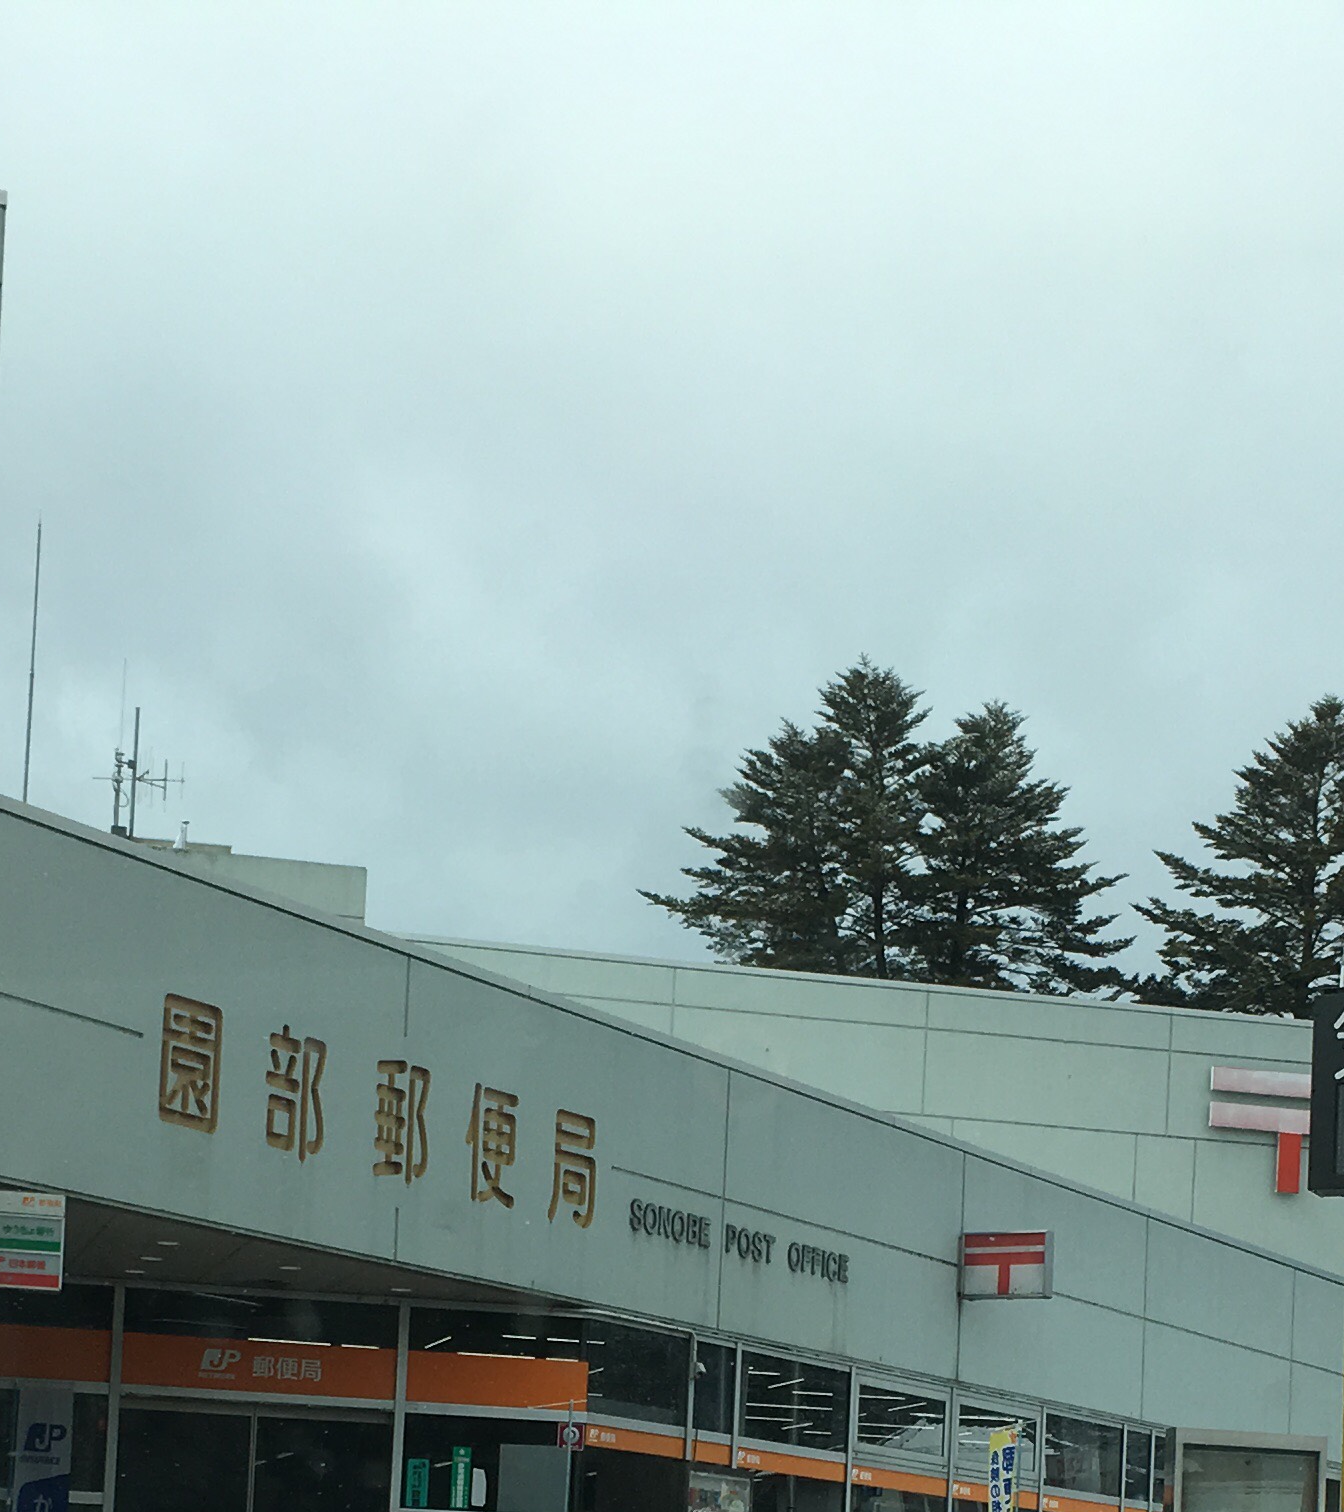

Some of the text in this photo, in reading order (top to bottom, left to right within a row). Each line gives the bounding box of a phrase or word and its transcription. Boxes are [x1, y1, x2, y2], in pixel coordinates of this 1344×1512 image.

[159, 992, 597, 1229] 園部郵便局
[629, 1198, 849, 1284] SONOBE POST OFFICE
[252, 1356, 323, 1382] 郵便局
